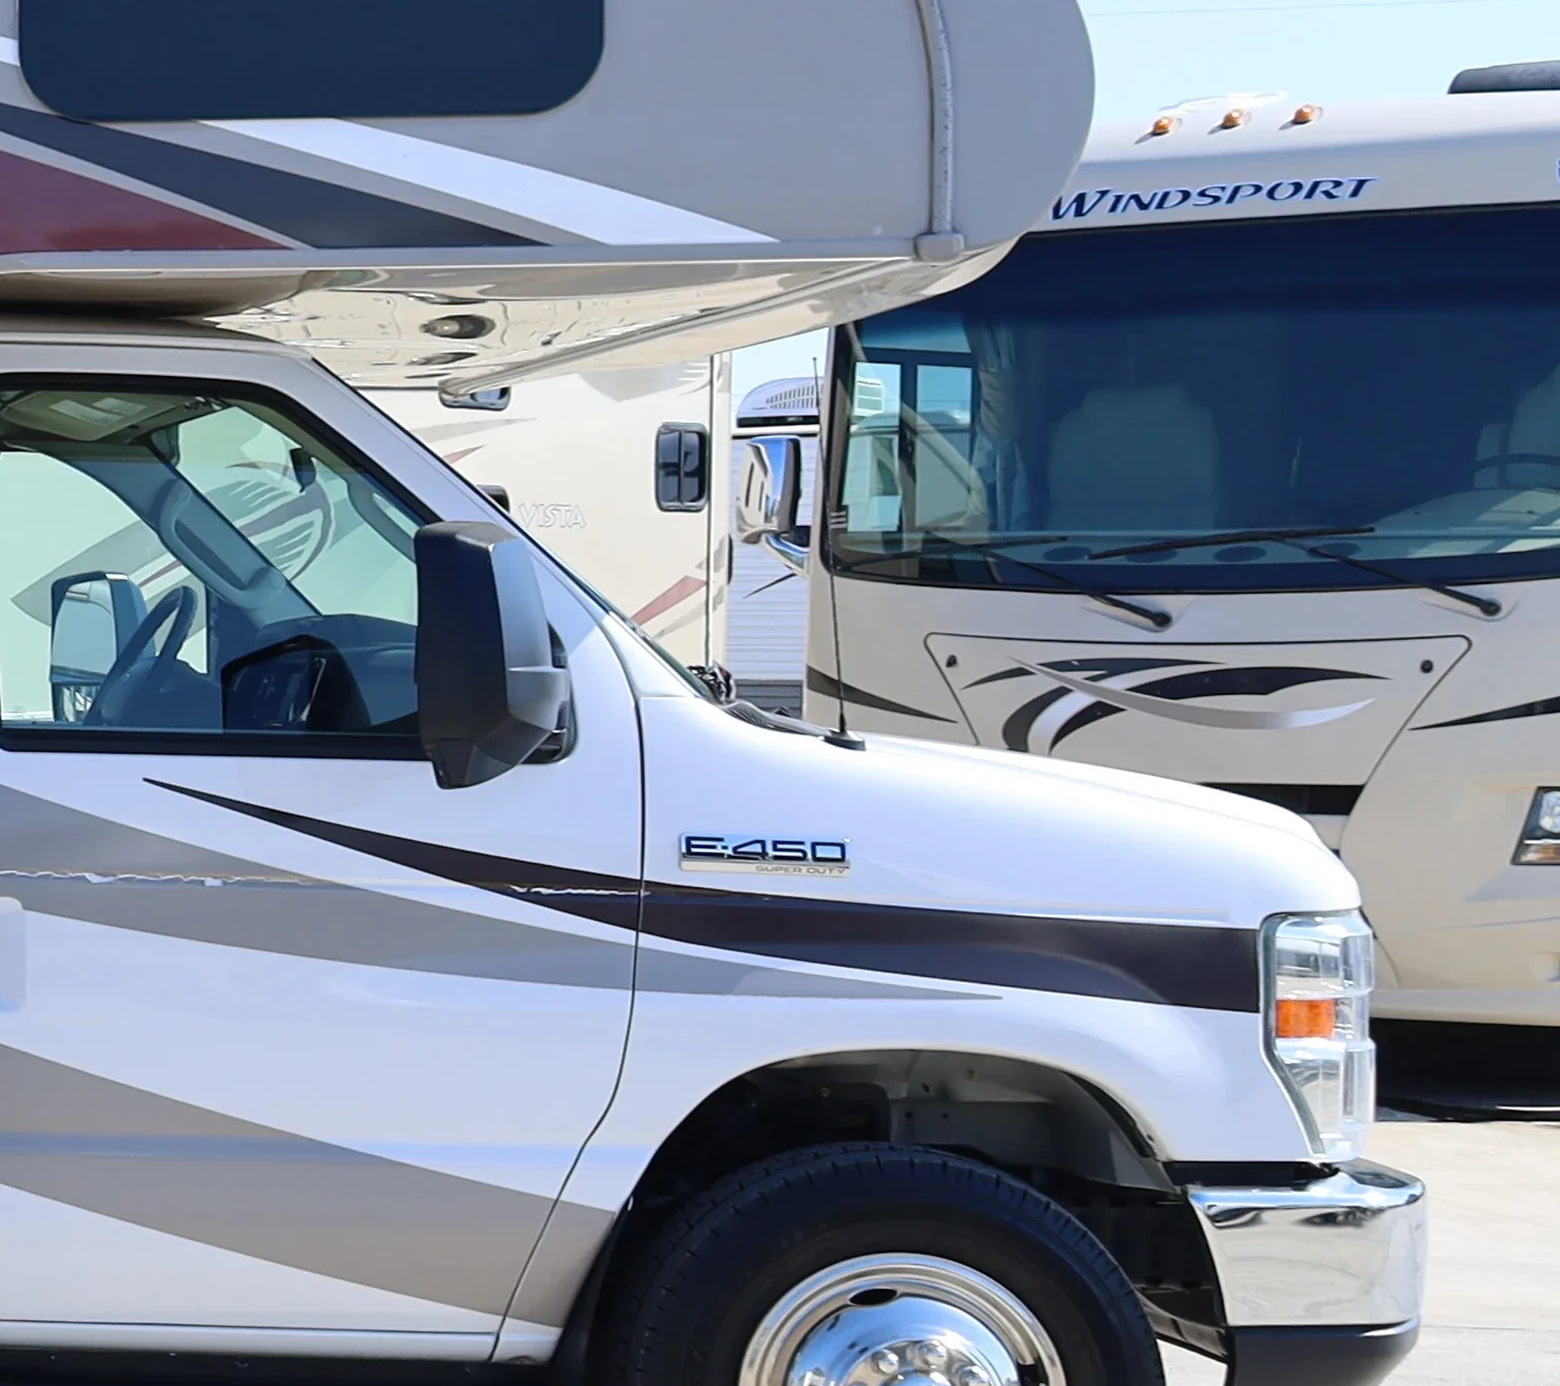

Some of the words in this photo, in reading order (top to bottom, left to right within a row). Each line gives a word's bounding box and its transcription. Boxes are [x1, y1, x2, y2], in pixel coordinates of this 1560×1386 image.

[1050, 176, 1382, 221] WINDSPORT
[518, 501, 588, 529] VISTA
[754, 865, 803, 874] SUPER
[806, 866, 846, 875] DUTY
